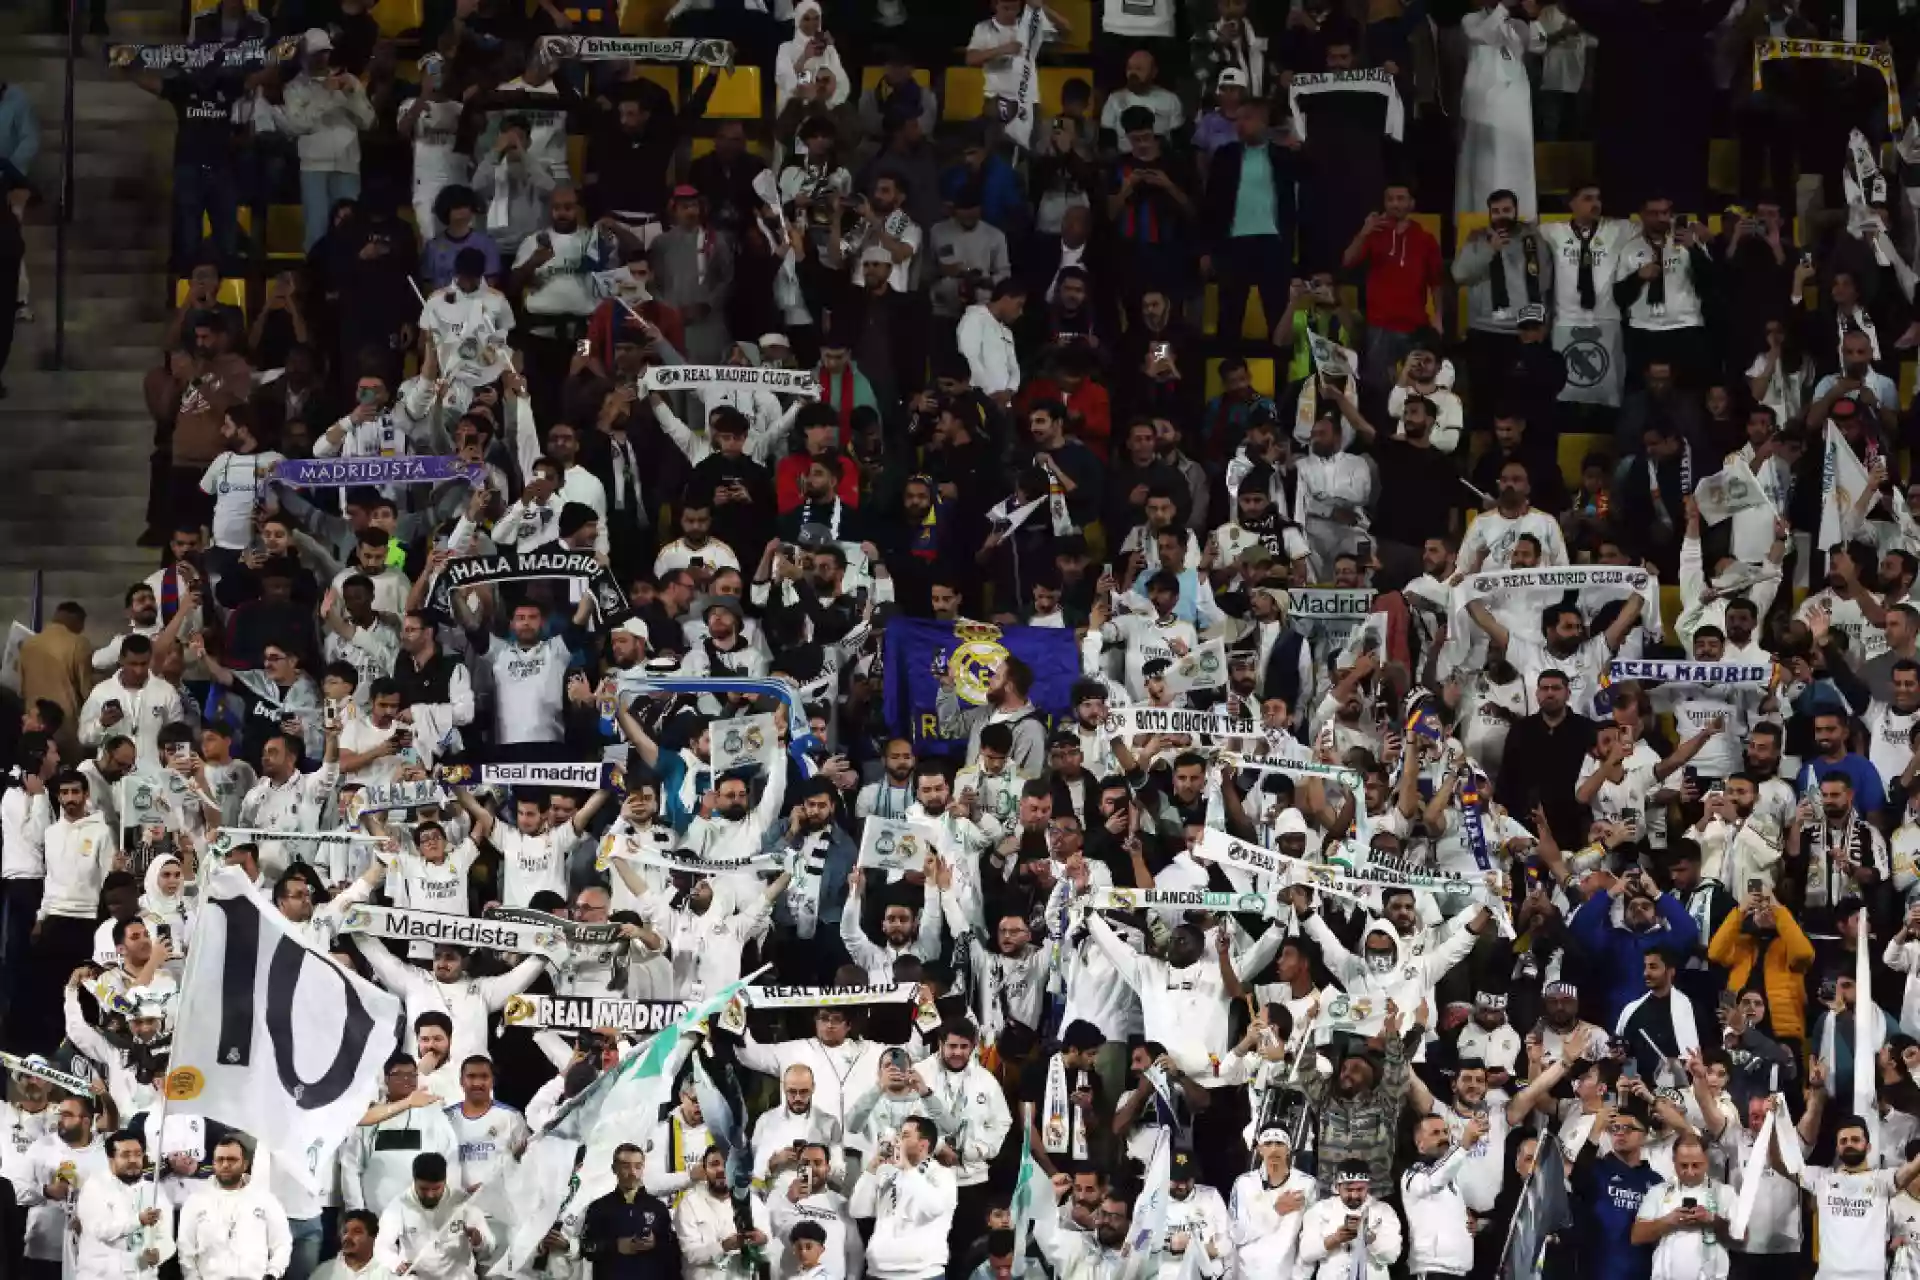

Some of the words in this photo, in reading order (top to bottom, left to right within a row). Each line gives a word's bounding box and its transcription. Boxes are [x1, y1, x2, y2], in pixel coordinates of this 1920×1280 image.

[683, 369, 712, 382] REAL
[716, 369, 758, 384] MADRID
[299, 460, 427, 479] MADRIDISTA
[1502, 574, 1536, 589] REAL
[1539, 572, 1587, 586] MADRID
[1289, 592, 1372, 614] Madrid
[1611, 662, 1668, 681] REAL
[1675, 664, 1765, 683] MADRID
[1136, 709, 1166, 730] CLUB
[1172, 710, 1220, 733] MADRID
[486, 764, 528, 780] Real
[531, 766, 597, 783] madrid
[1144, 890, 1204, 905] BLANCOS
[386, 912, 518, 946] Madridista
[764, 986, 815, 998] REAL
[539, 998, 592, 1029] REAL
